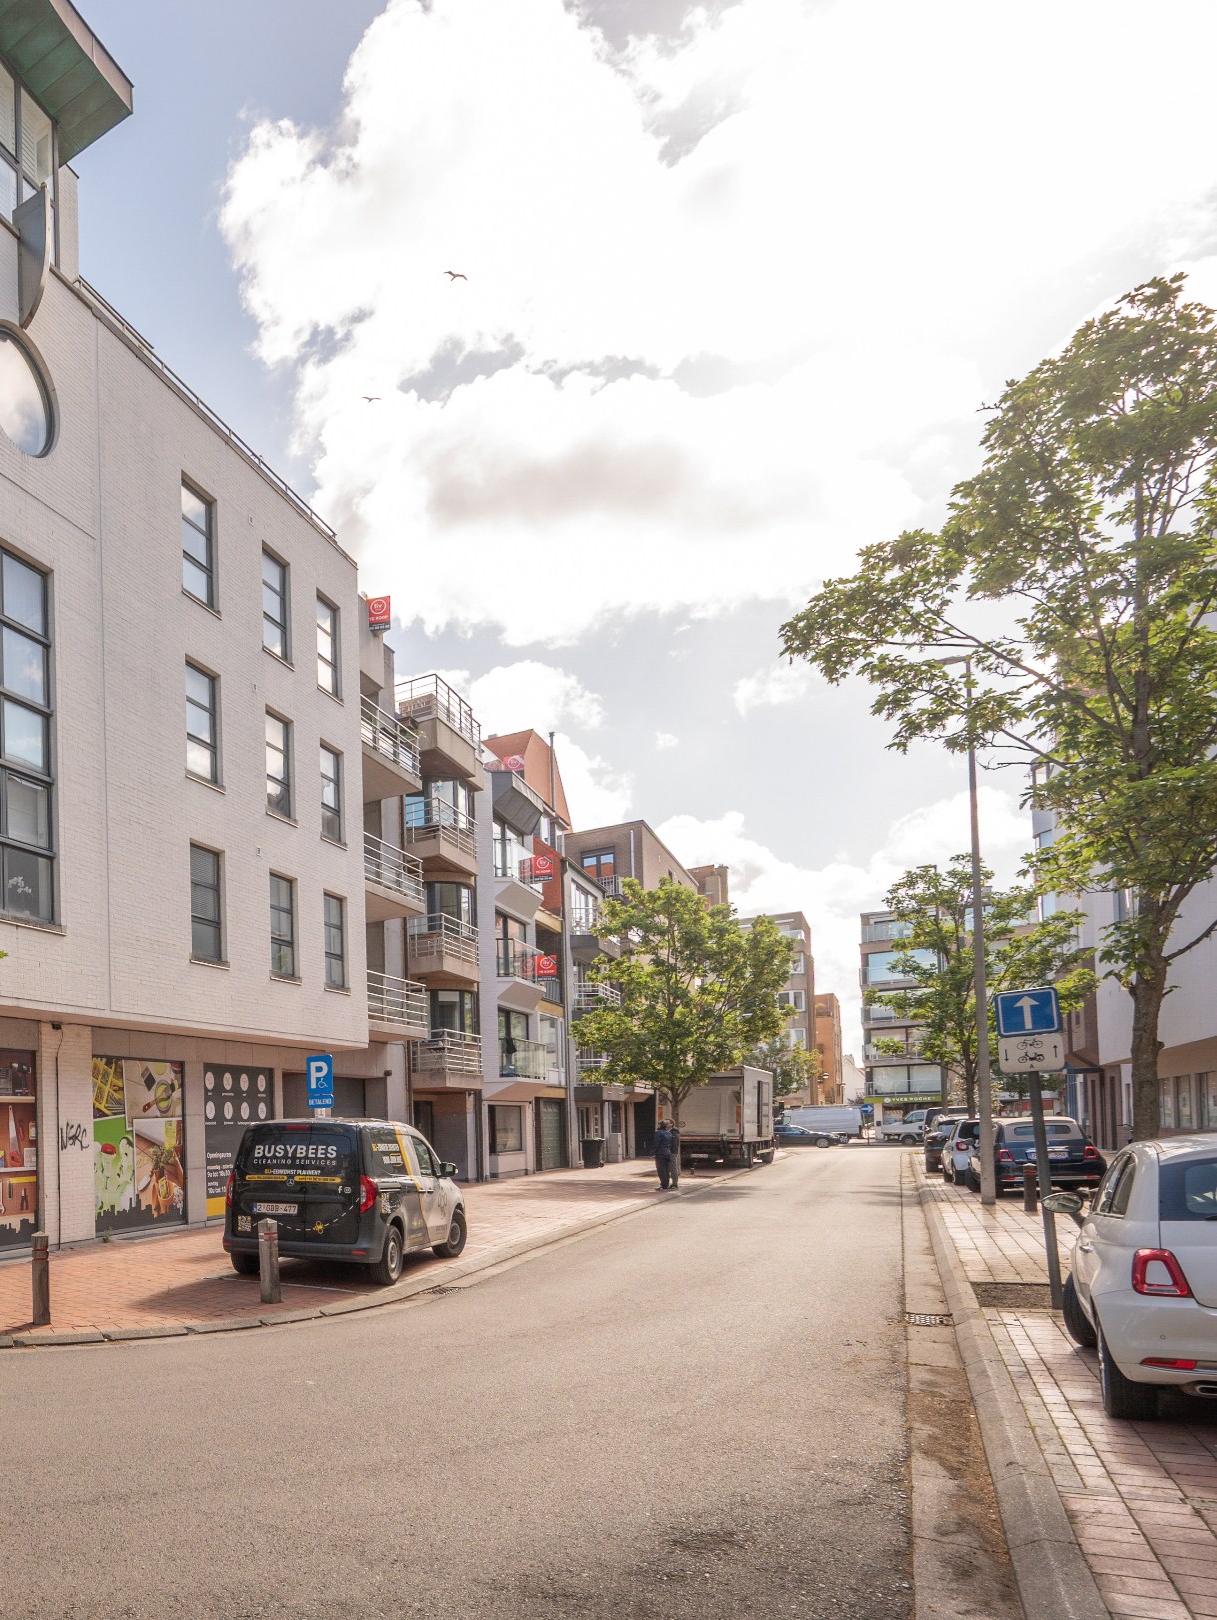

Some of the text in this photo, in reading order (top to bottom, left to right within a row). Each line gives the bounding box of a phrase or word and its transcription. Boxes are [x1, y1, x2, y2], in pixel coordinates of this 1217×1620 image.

[310, 1061, 328, 1089] P
[308, 1098, 332, 1106] BETALEND
[254, 1144, 337, 1158] BUSYBEES
